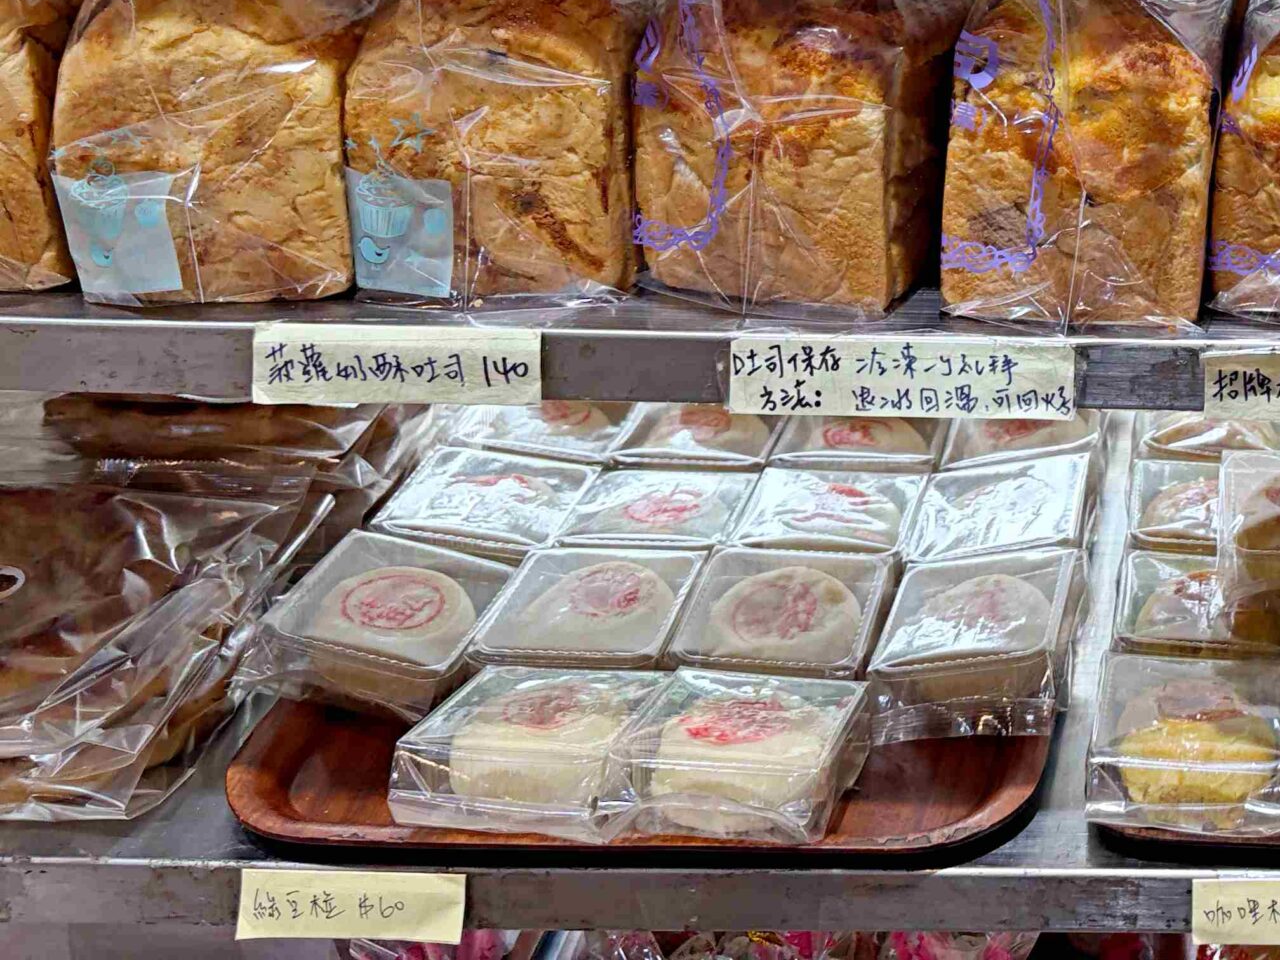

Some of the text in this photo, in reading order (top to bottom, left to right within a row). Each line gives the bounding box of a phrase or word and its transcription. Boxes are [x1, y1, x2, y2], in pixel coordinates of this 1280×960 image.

[482, 355, 530, 387] 140
[732, 344, 842, 378] 吐司保存
[357, 894, 406, 920] $60
